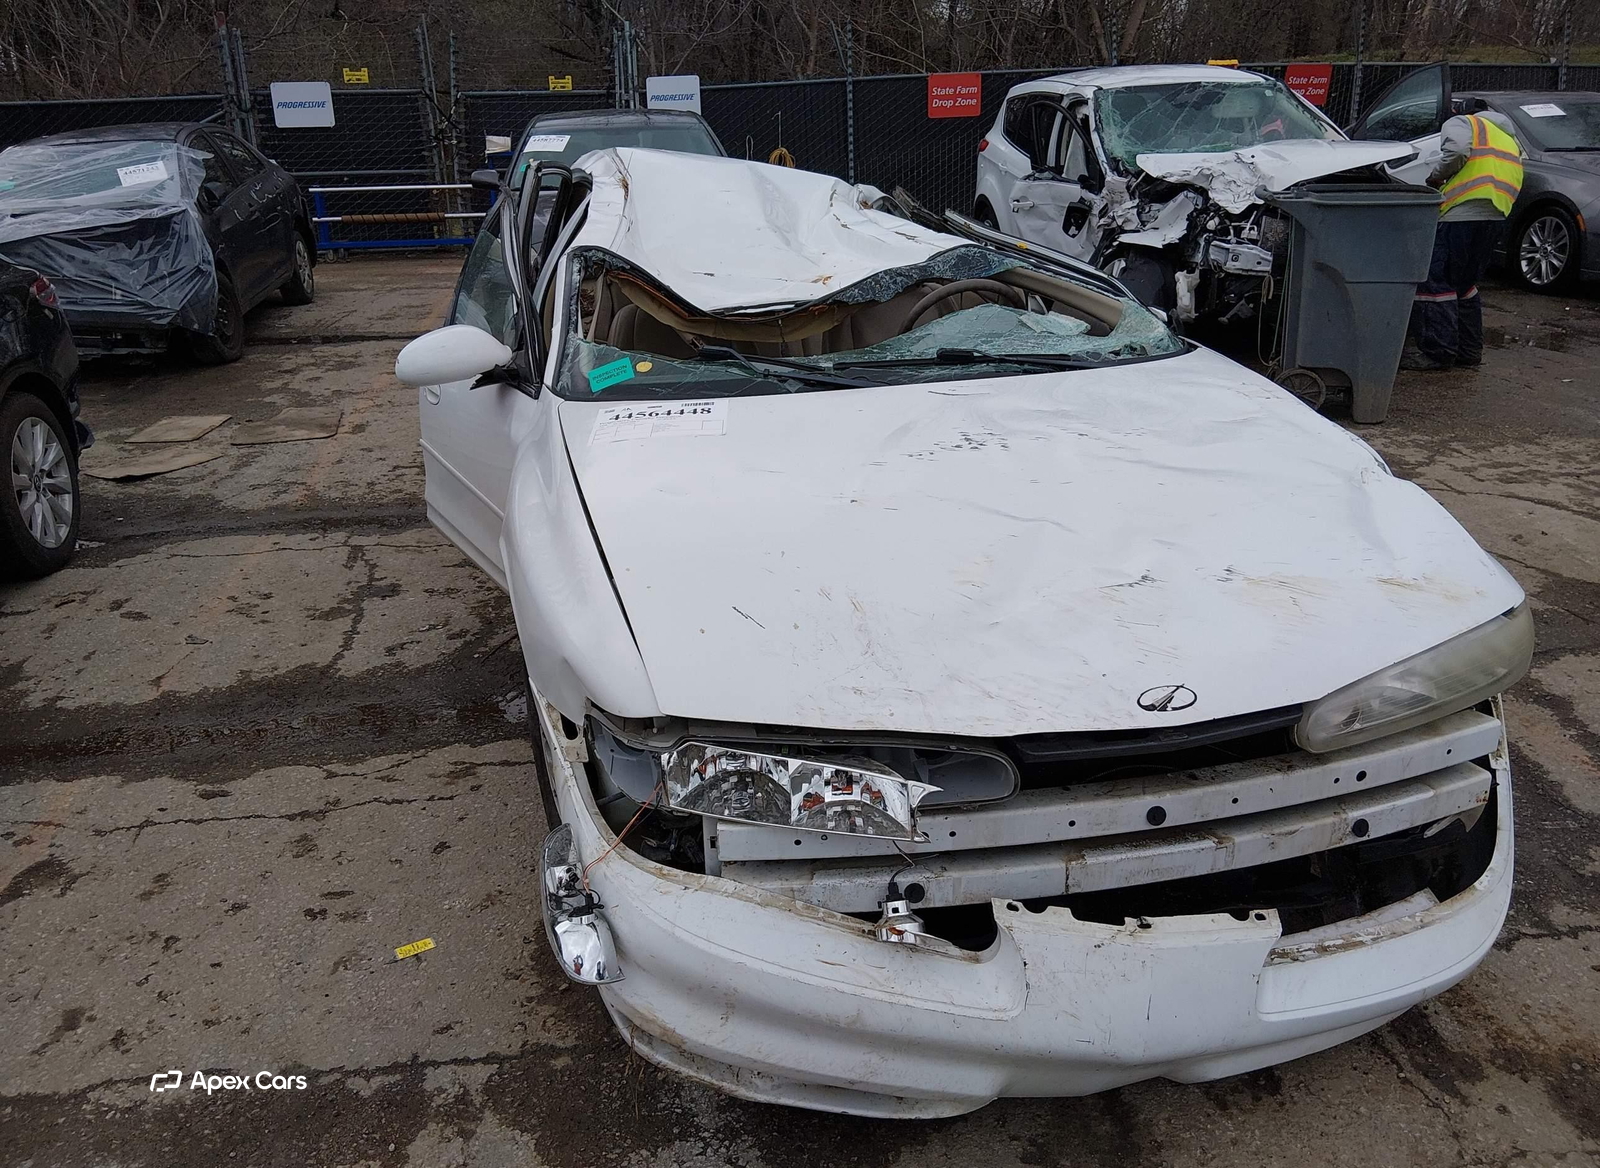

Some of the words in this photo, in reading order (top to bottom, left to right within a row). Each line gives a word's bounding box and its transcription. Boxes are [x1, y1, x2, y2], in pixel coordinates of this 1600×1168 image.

[1288, 76, 1308, 85] State
[1309, 76, 1328, 84] Farm
[932, 86, 954, 95] State
[956, 85, 978, 94] Farm
[1306, 87, 1325, 95] Zone
[650, 93, 695, 102] PROGRESSIVE
[276, 100, 327, 109] PROGRESSIVE
[932, 98, 953, 108] Drop
[955, 98, 977, 106] Zone
[592, 364, 627, 380] INSPECTION
[596, 369, 627, 384] COMPLETE
[609, 407, 712, 420] 44564448
